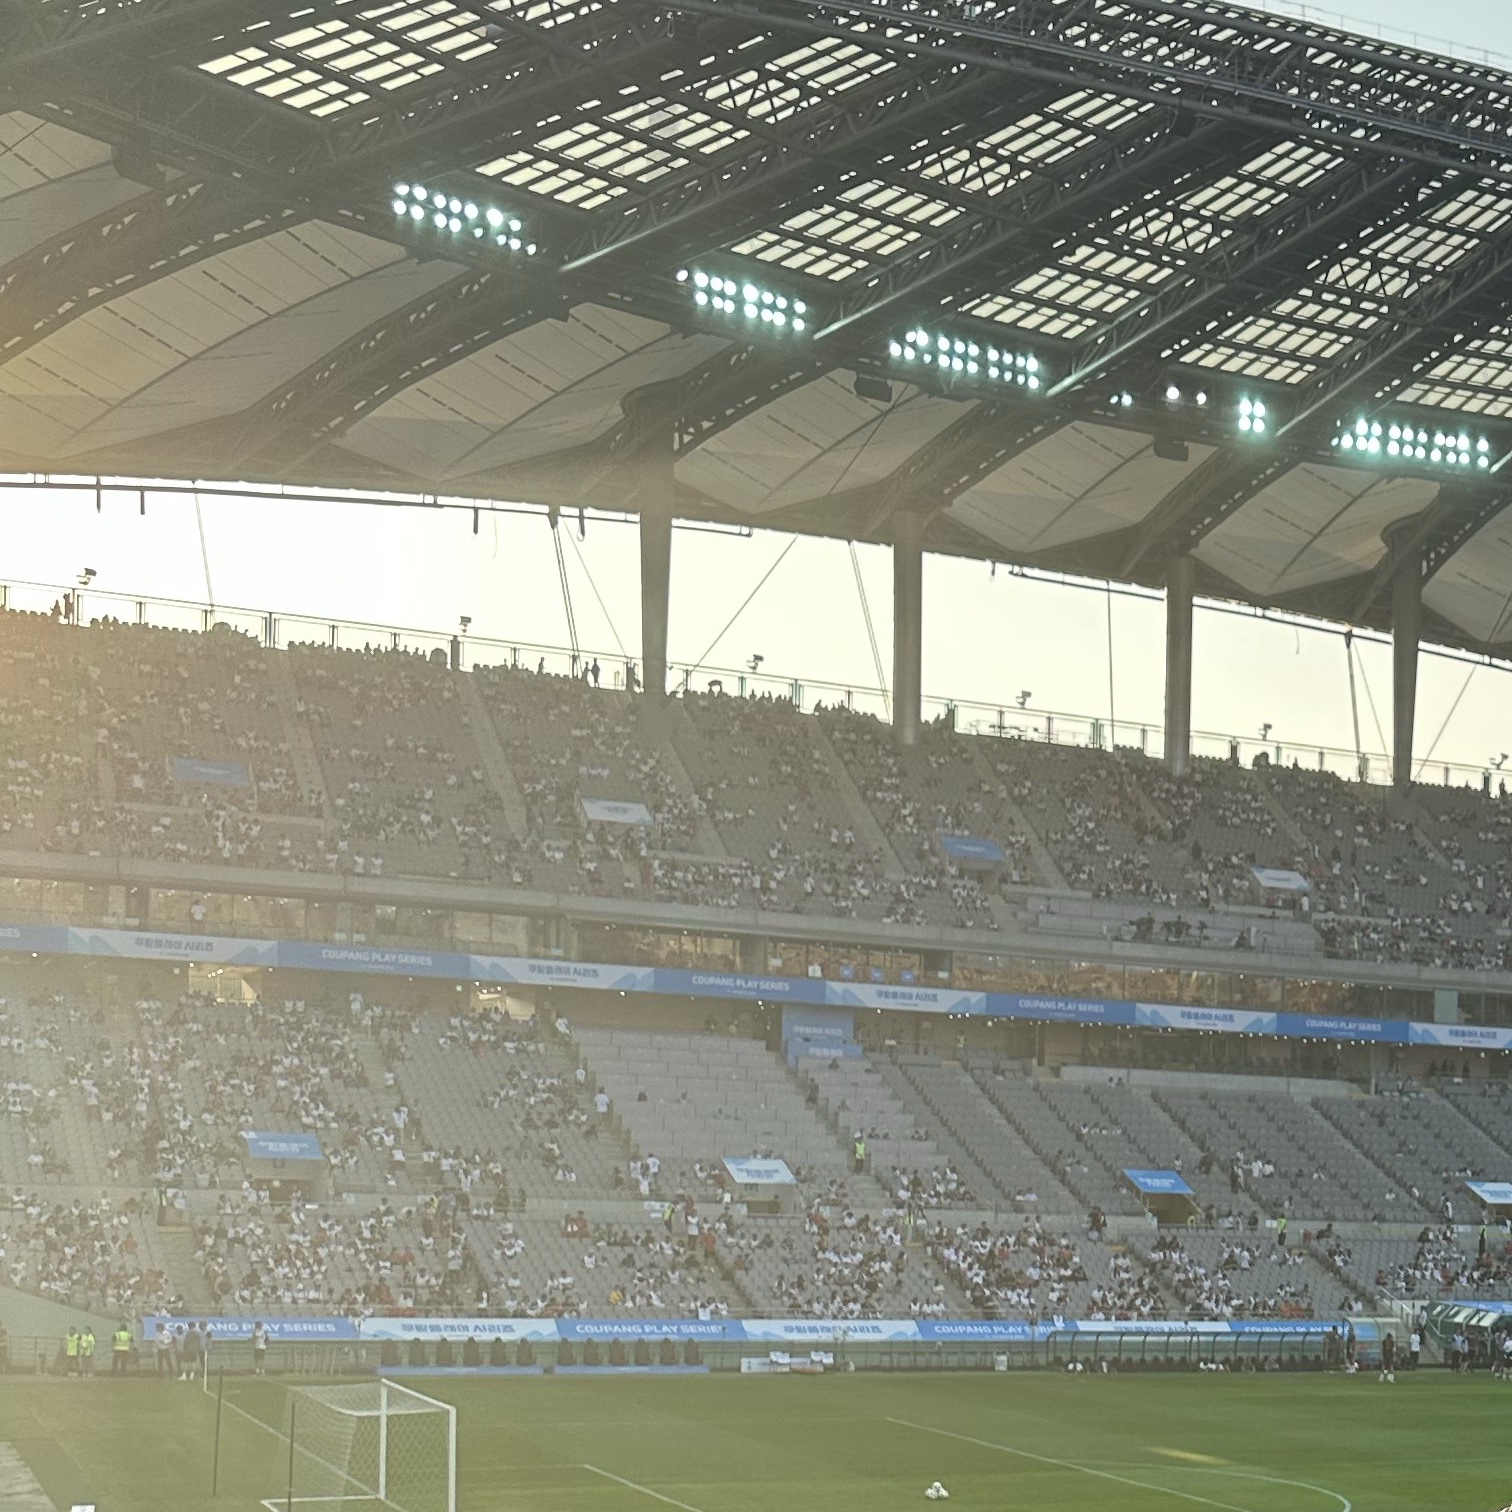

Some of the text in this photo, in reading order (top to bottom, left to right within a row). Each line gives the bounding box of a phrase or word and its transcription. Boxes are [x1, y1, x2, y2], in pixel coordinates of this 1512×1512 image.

[322, 949, 433, 966] COUPANG PLAY SERIES
[692, 975, 790, 991] COUPANG PLAY SERIES
[243, 1322, 280, 1333] PAY
[283, 1323, 336, 1333] SERIES
[576, 1324, 641, 1334] COUPANG
[644, 1324, 679, 1334] PLAY
[934, 1325, 991, 1334] COUPANG
[993, 1325, 1024, 1334] PLAY
